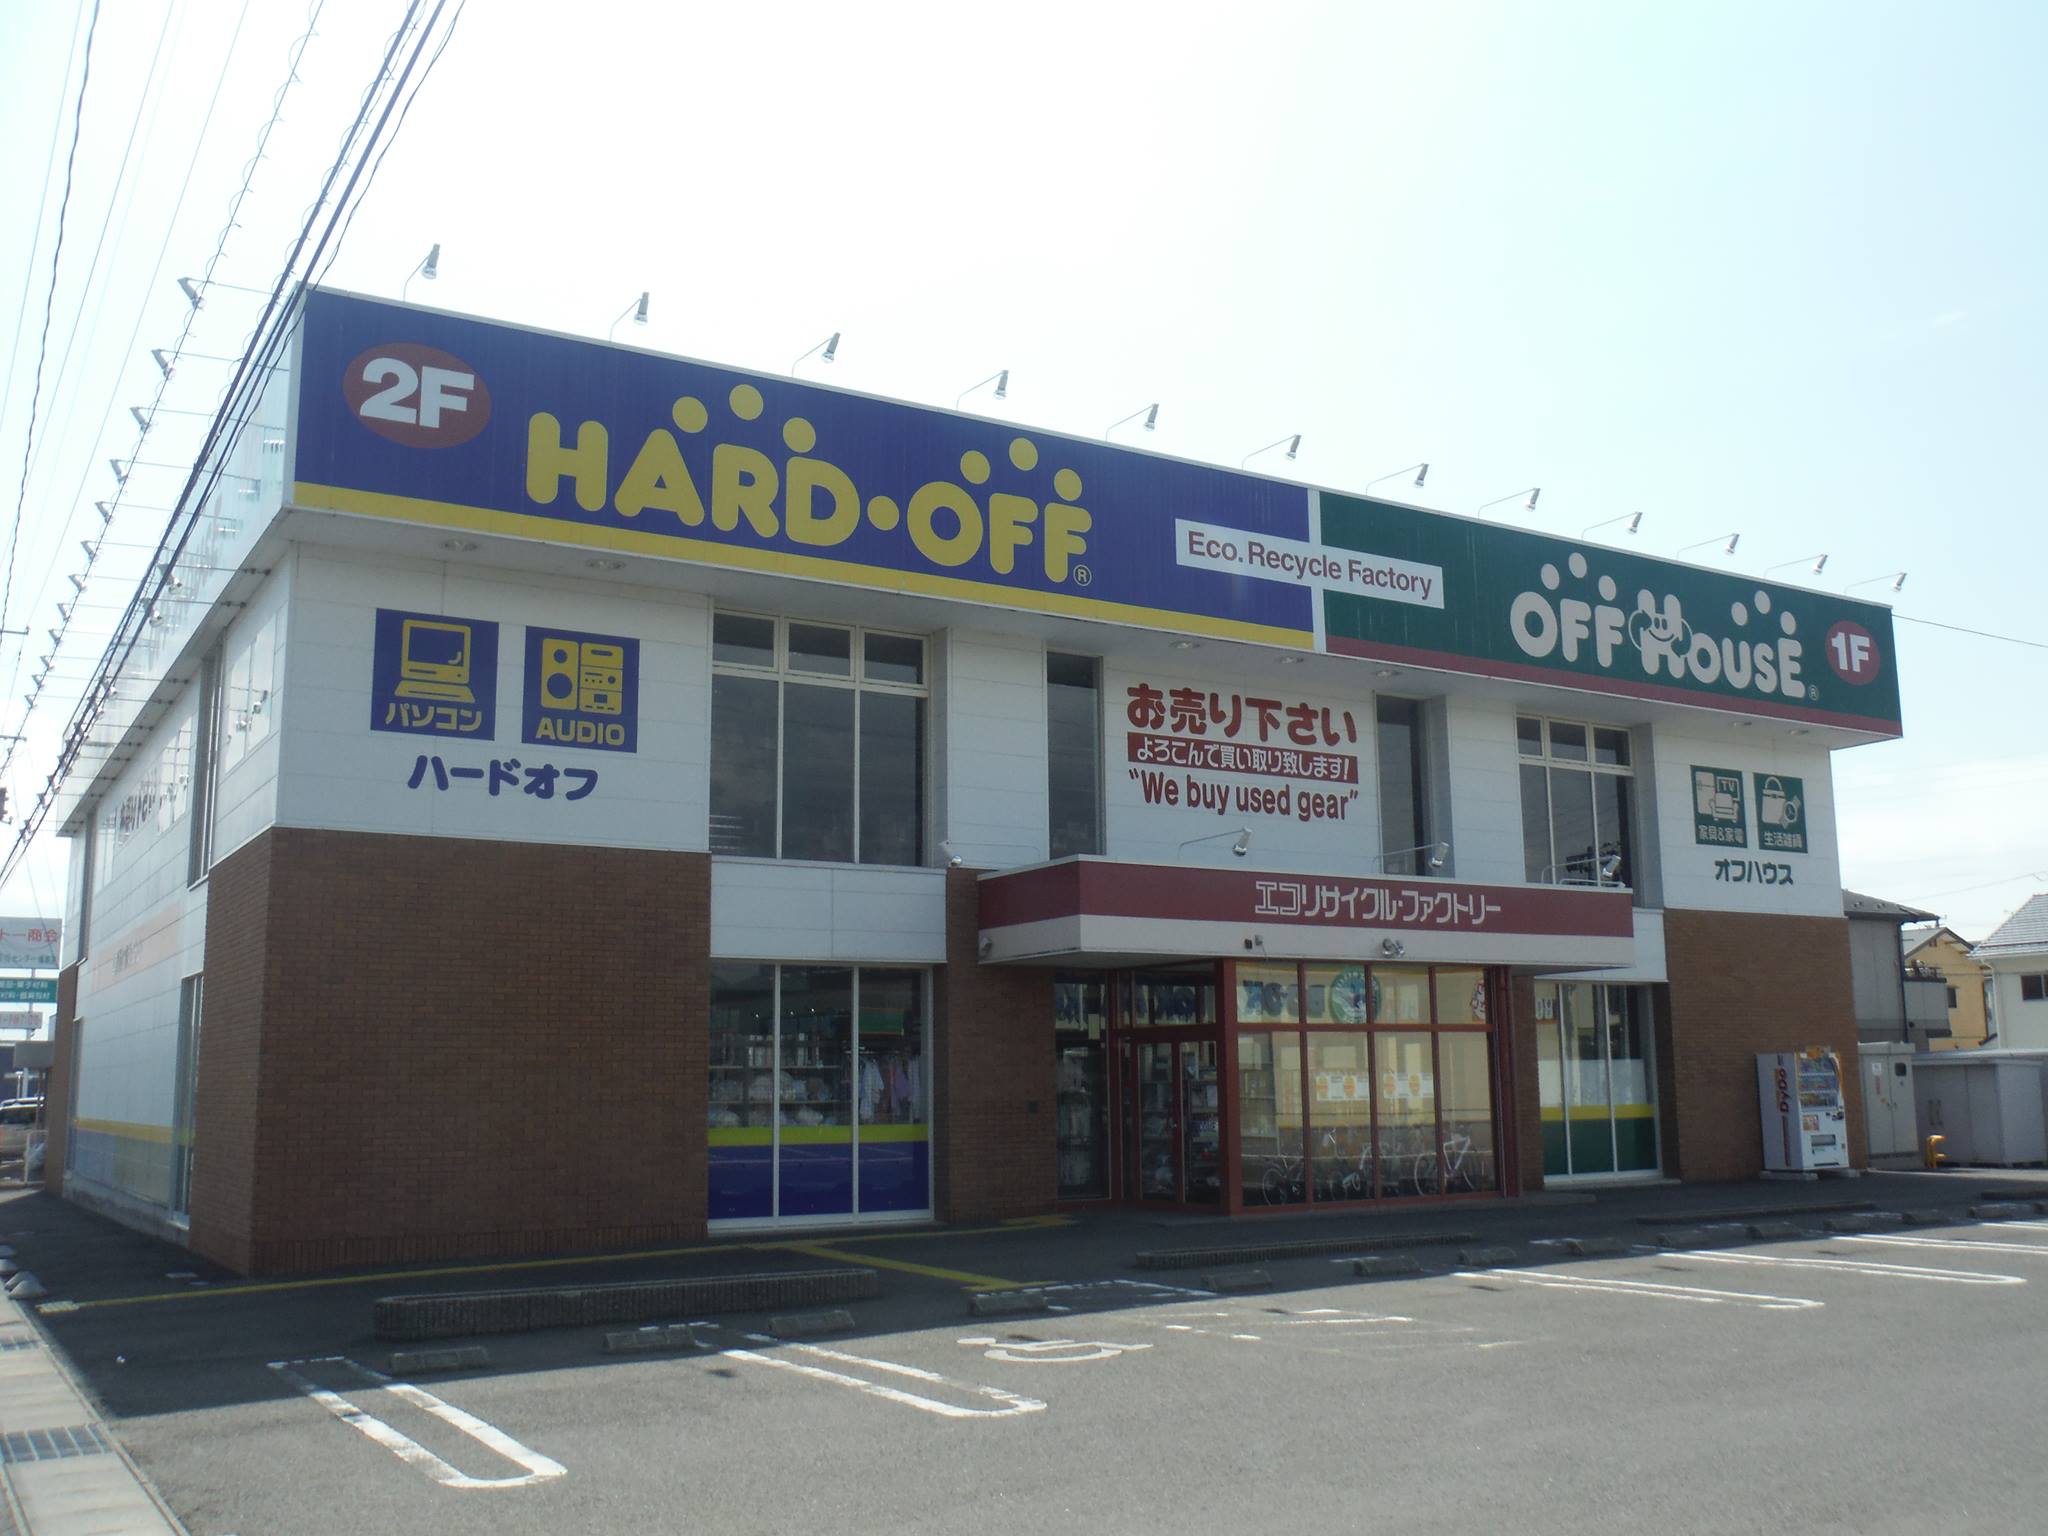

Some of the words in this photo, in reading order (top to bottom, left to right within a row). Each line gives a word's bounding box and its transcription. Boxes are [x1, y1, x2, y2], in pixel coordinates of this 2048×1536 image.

[360, 357, 475, 429] 2F
[1248, 541, 1342, 581] Recycle
[1348, 559, 1434, 602] Factory
[1510, 591, 1626, 669] OFF
[1636, 588, 1806, 700] HOUSE
[1831, 631, 1871, 673] 1F
[384, 702, 483, 733] パソコン
[535, 716, 626, 746] AUDIO
[1126, 682, 1358, 747] お売り下さい
[407, 754, 599, 801] ハードオフ
[1186, 773, 1230, 816] buy
[1236, 784, 1290, 816] used
[1713, 858, 1795, 886] オフハウス
